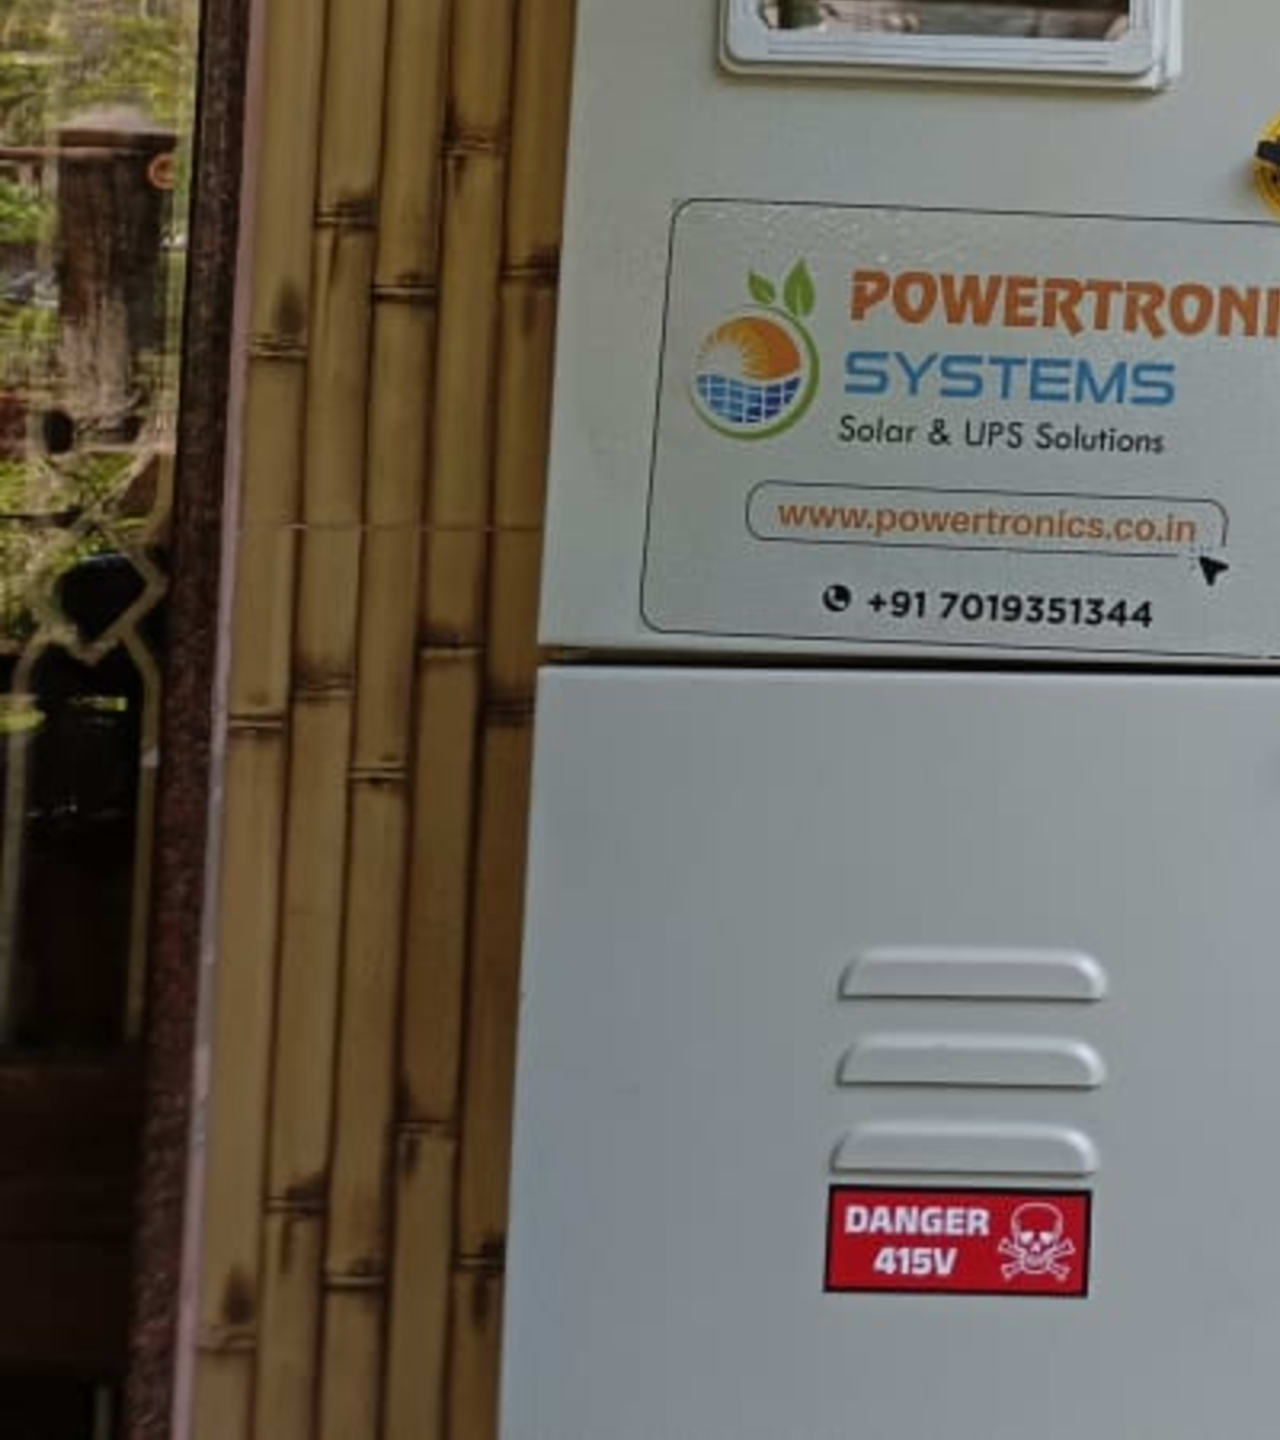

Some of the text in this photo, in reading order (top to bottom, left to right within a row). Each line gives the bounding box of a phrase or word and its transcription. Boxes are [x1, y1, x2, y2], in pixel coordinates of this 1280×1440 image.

[844, 351, 1177, 408] SYSTEMS
[838, 416, 1165, 455] Solar & UPS Solutions
[778, 500, 1197, 544] www.powertronics.co.in
[867, 590, 1153, 628] +91 7019351344
[844, 1204, 990, 1238] DANGER
[874, 1244, 958, 1277] 415V
